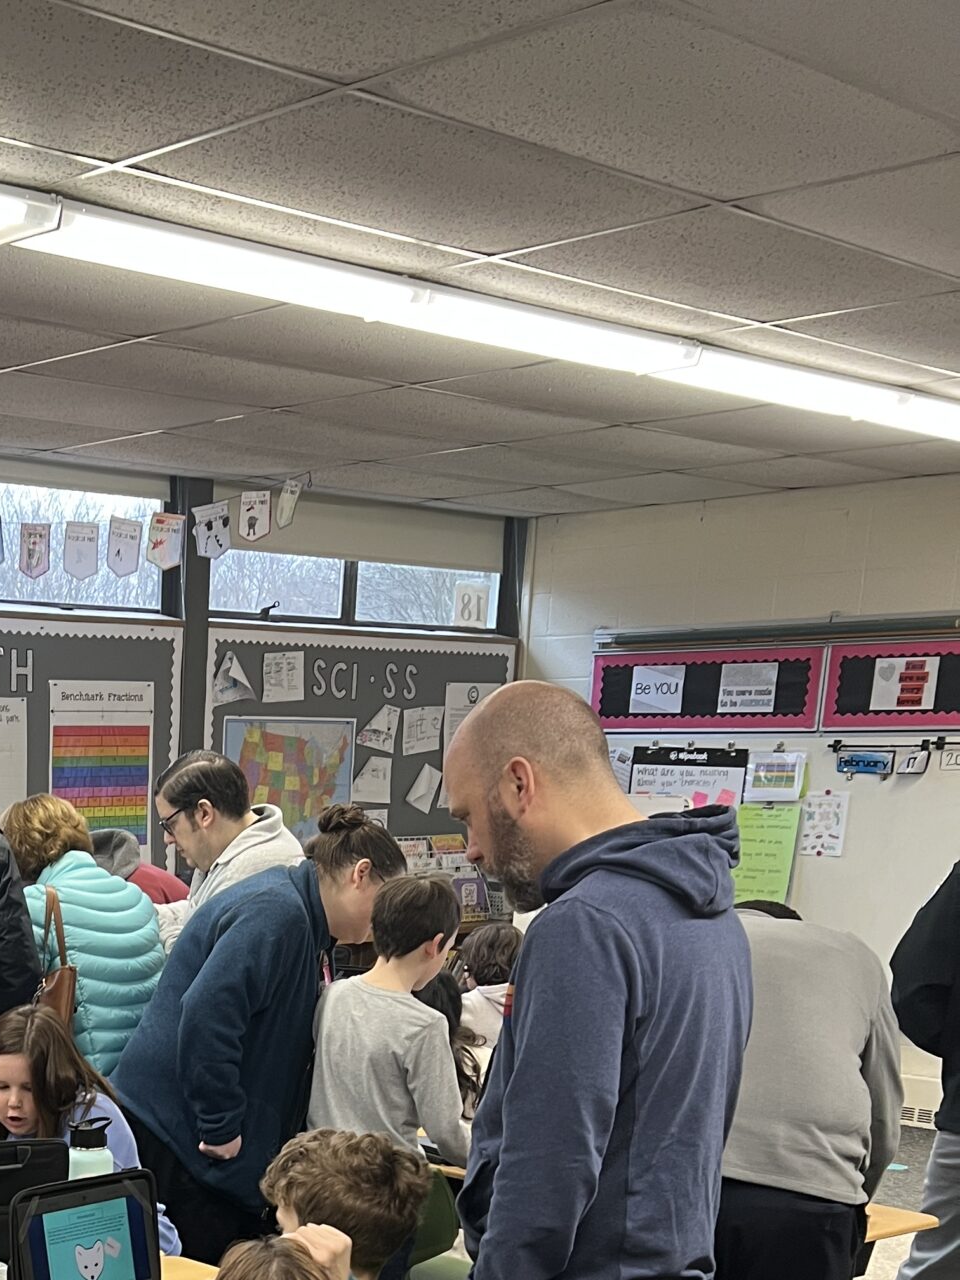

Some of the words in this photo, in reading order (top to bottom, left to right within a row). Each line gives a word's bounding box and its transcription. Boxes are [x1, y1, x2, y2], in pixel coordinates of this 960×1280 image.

[311, 657, 359, 701] SCI
[381, 662, 419, 701] SS
[634, 682, 651, 695] Be
[654, 681, 679, 695] YOU!
[721, 688, 734, 697] You
[61, 691, 105, 701] Benchmark
[107, 691, 144, 702] Fractions
[720, 699, 728, 707] to
[729, 699, 738, 707] be
[839, 756, 891, 770] February
[637, 767, 659, 777] What
